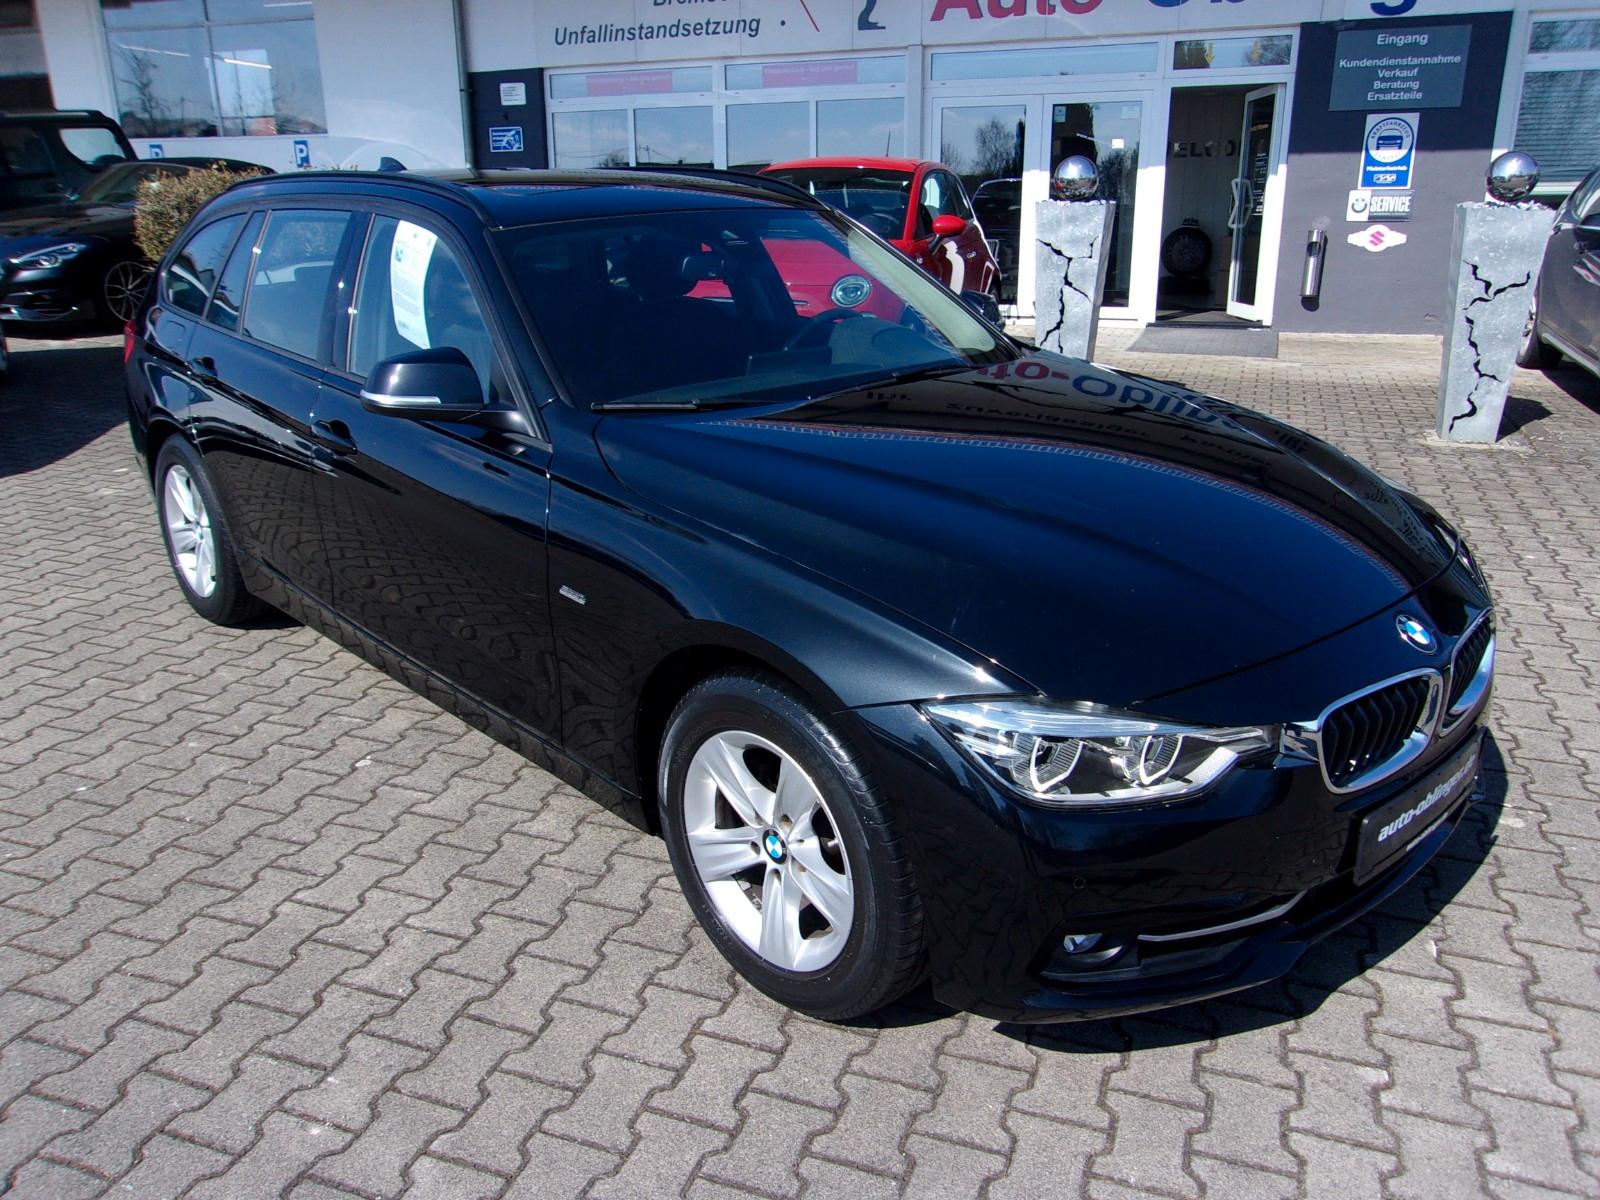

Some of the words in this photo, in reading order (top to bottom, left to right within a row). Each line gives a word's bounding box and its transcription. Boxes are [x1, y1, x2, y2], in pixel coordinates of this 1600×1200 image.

[554, 17, 761, 46] Unfallinstandsetzung
[1376, 33, 1429, 47] Eingang
[1339, 54, 1461, 68] Kundendienstannahme
[1377, 68, 1419, 78] Verkauf
[1373, 80, 1420, 90] Beratung
[1367, 91, 1423, 101] Ersatzteile
[296, 144, 308, 168] P
[1370, 196, 1411, 212] SERVICE
